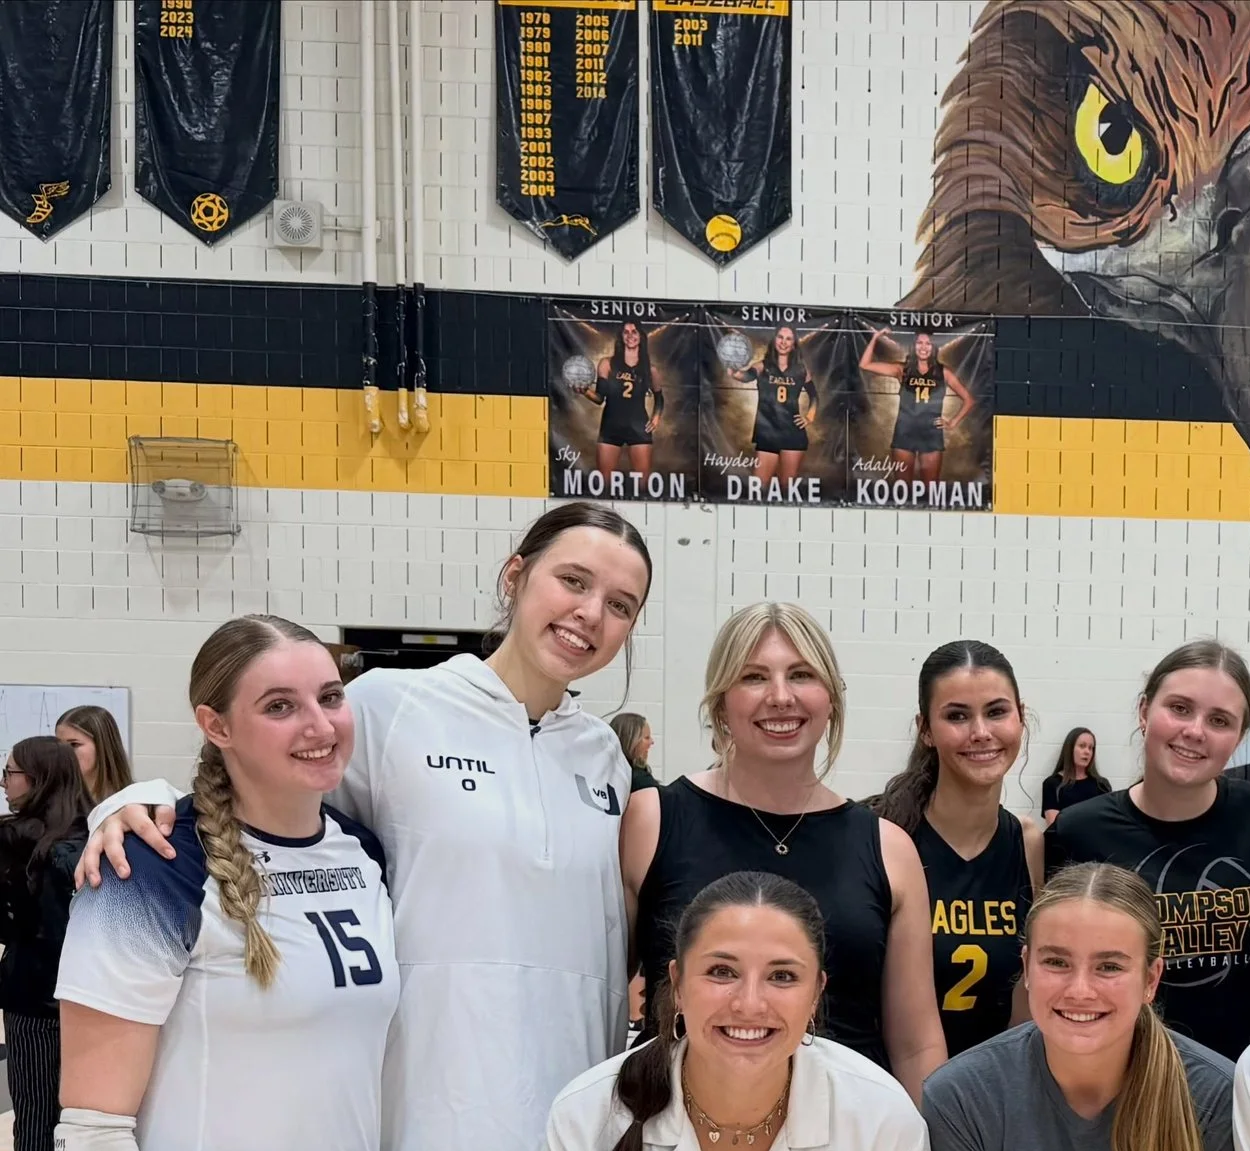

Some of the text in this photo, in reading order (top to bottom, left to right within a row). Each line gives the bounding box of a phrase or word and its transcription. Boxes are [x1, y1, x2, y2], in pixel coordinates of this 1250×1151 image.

[160, 11, 194, 24] 2023
[576, 14, 610, 27] 2005
[674, 18, 708, 32] 2003
[160, 25, 193, 38] 2024
[520, 27, 551, 39] 1979
[576, 29, 609, 41] 2006
[674, 33, 703, 46] 2011
[576, 43, 609, 56] 2007
[576, 58, 604, 71] 2011
[576, 72, 607, 84] 2012
[576, 86, 607, 98] 2014
[520, 127, 551, 139] 1993
[520, 142, 551, 154] 2001
[520, 156, 554, 168] 2002
[520, 170, 554, 182] 2003
[520, 183, 555, 197] 2004
[591, 300, 658, 317] SENIOR
[741, 306, 807, 323] SENIOR
[889, 311, 954, 328] SENIOR
[622, 381, 634, 398] 2
[777, 385, 787, 403] 8
[915, 386, 930, 403] 14
[555, 446, 581, 468] Sky
[703, 452, 761, 475] Hayden
[852, 456, 907, 477] Adalyn
[563, 469, 686, 499] MORTON
[727, 475, 822, 504] DRAKE
[857, 478, 983, 508] KOOPMAN
[426, 755, 495, 774] UNTIL
[261, 867, 367, 897] NIVERSITY
[932, 899, 1017, 936] AGLES
[1160, 920, 1249, 957] ALLEY
[304, 909, 383, 988] 15
[1166, 954, 1249, 970] LLEYBALL
[942, 944, 988, 1011] 2
